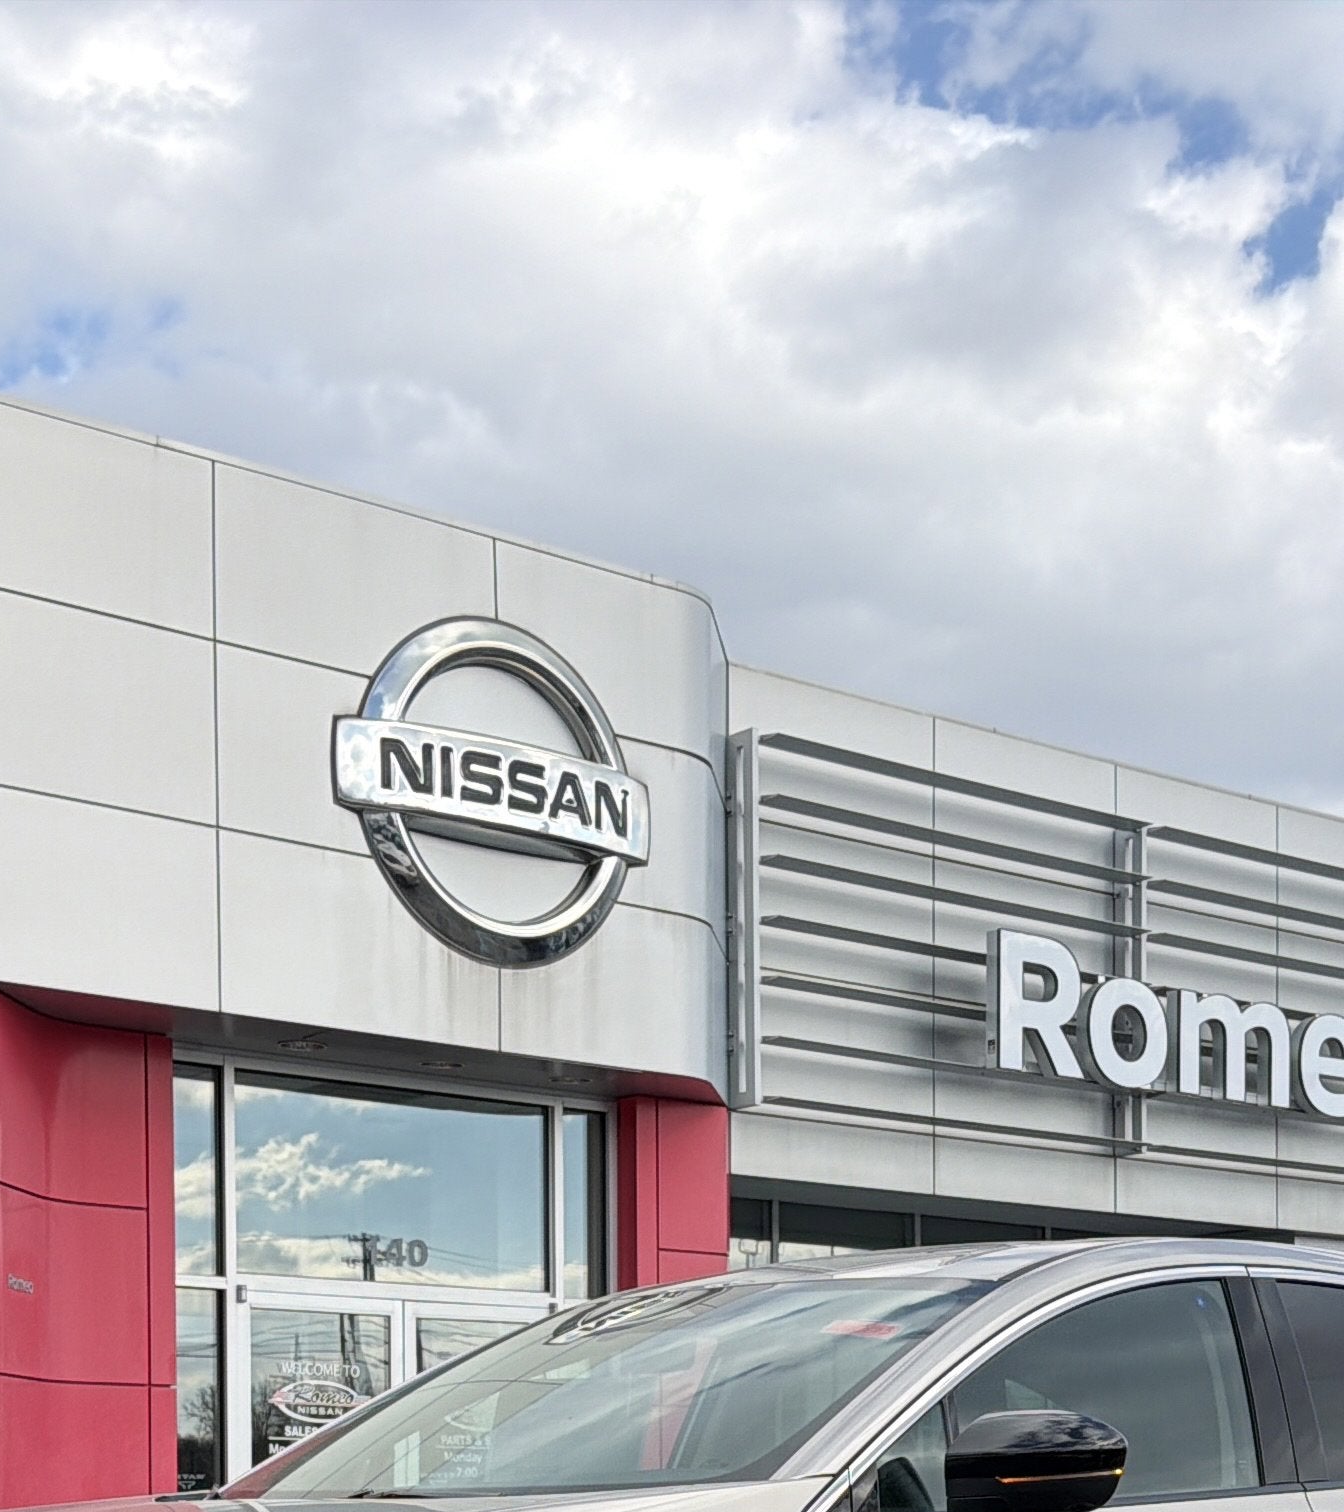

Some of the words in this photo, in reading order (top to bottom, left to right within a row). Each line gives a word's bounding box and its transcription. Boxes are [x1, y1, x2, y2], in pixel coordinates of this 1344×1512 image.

[379, 736, 630, 841] NISSAN
[368, 1238, 428, 1268] 140
[280, 1360, 340, 1377] WELCOME
[342, 1364, 361, 1378] TO
[288, 1382, 355, 1405] Romeo
[296, 1406, 343, 1416] NISSAN
